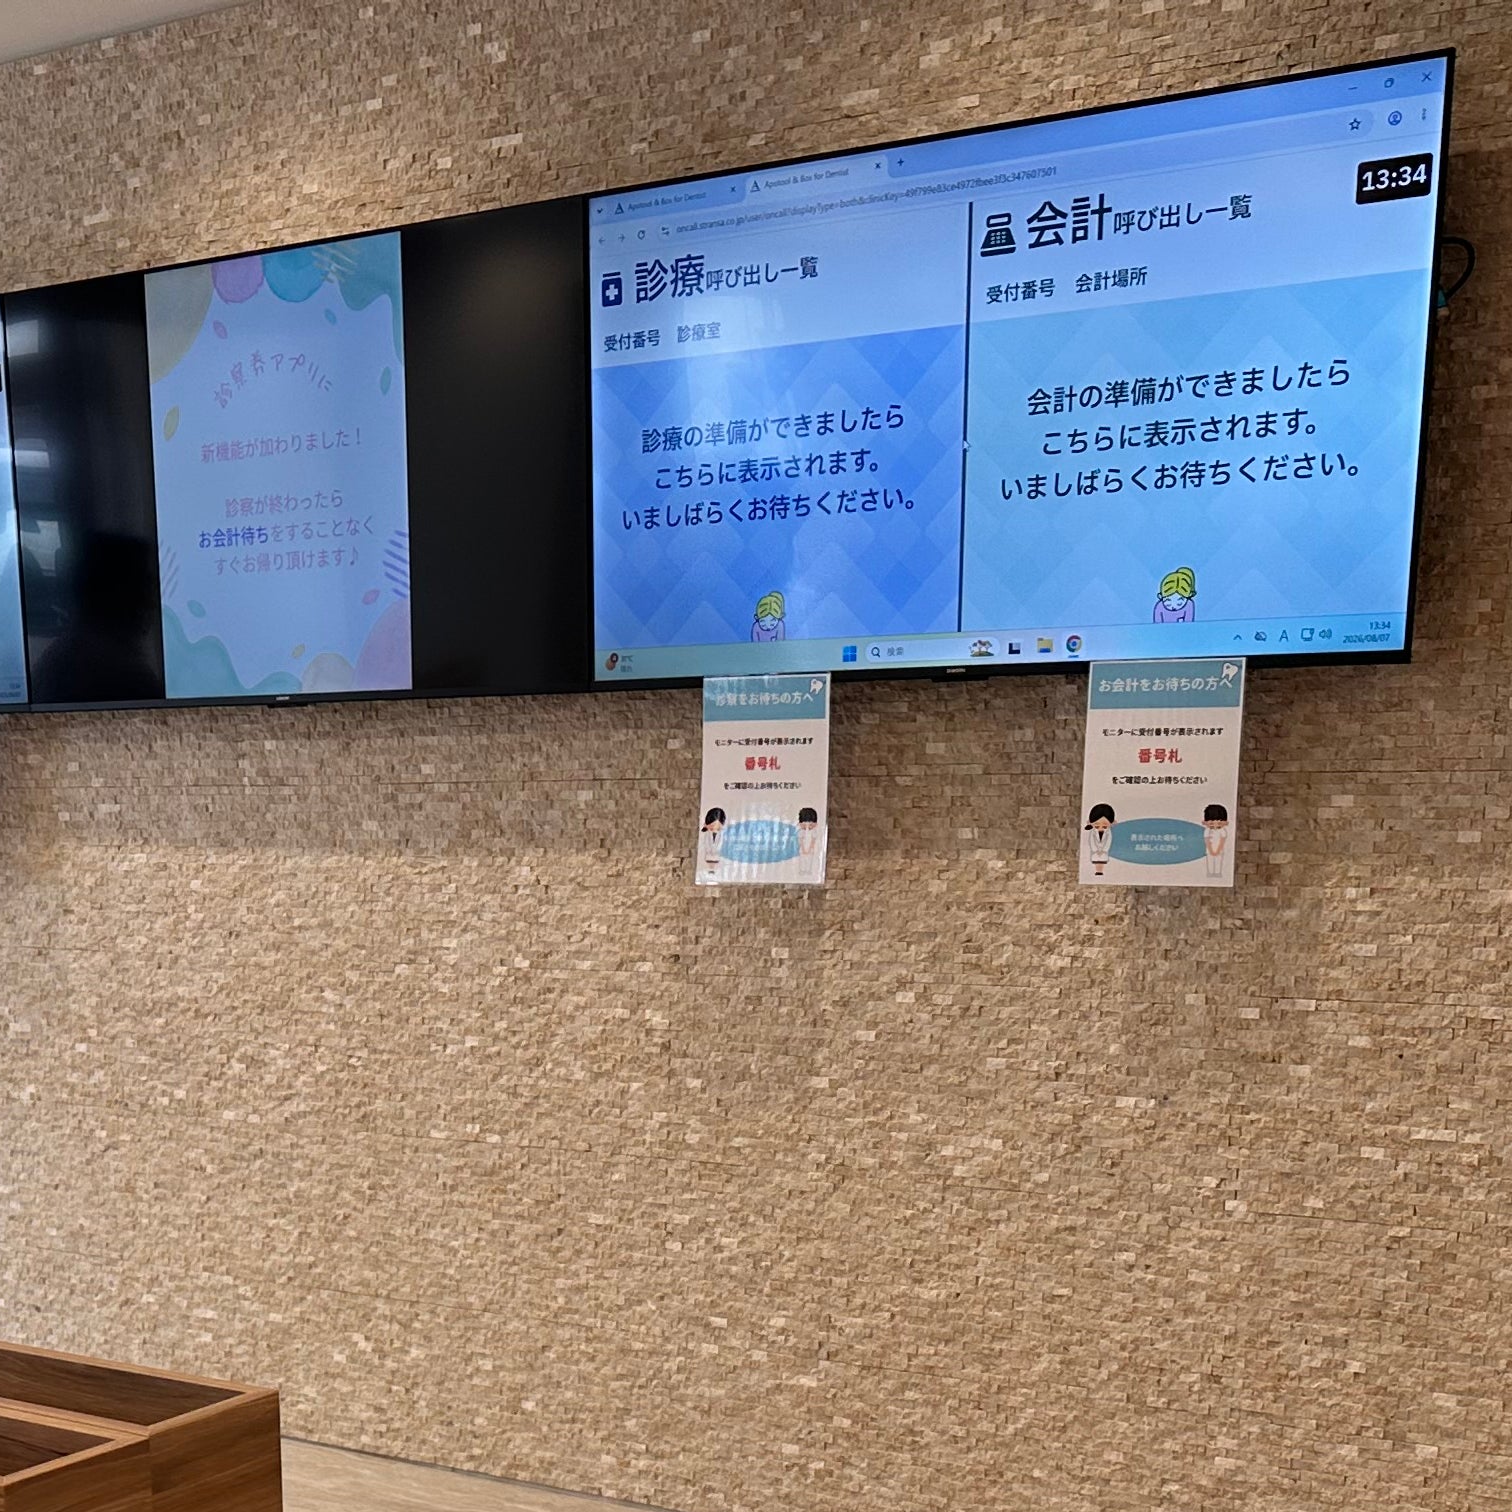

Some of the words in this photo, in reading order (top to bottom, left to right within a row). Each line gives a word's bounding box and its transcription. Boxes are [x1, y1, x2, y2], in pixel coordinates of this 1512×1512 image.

[1361, 163, 1427, 193] 13:34
[1026, 193, 1253, 250] 会計呼び出し一覧
[635, 254, 819, 304] 診療呼び出し一覧
[986, 277, 1056, 306] 受付番号
[1075, 266, 1148, 294] 会計場所
[603, 329, 661, 353] 受付番号
[677, 322, 721, 343] 診療室
[1027, 359, 1351, 416] 会計の準備ができましたら
[641, 404, 905, 454] 診療の準備ができましたら
[1042, 408, 1317, 455] こちらに表示されます。
[655, 448, 878, 490] こちらに表示されます。
[1000, 452, 1360, 501] いましばらくお待ちください。
[224, 490, 343, 519] 診察が終わったら
[622, 488, 915, 531] いましばらくお待ちください。
[198, 514, 374, 549] お会計待ちをすることなく
[1369, 621, 1391, 632] 13:34
[1098, 676, 1233, 694] お会計をお待ちの方へ
[1102, 727, 1224, 737] モニターに受付番号が表示されます
[745, 756, 781, 771] 番号札
[1138, 748, 1182, 768] 番号札
[1112, 776, 1208, 785] をご確認の上お待ちください
